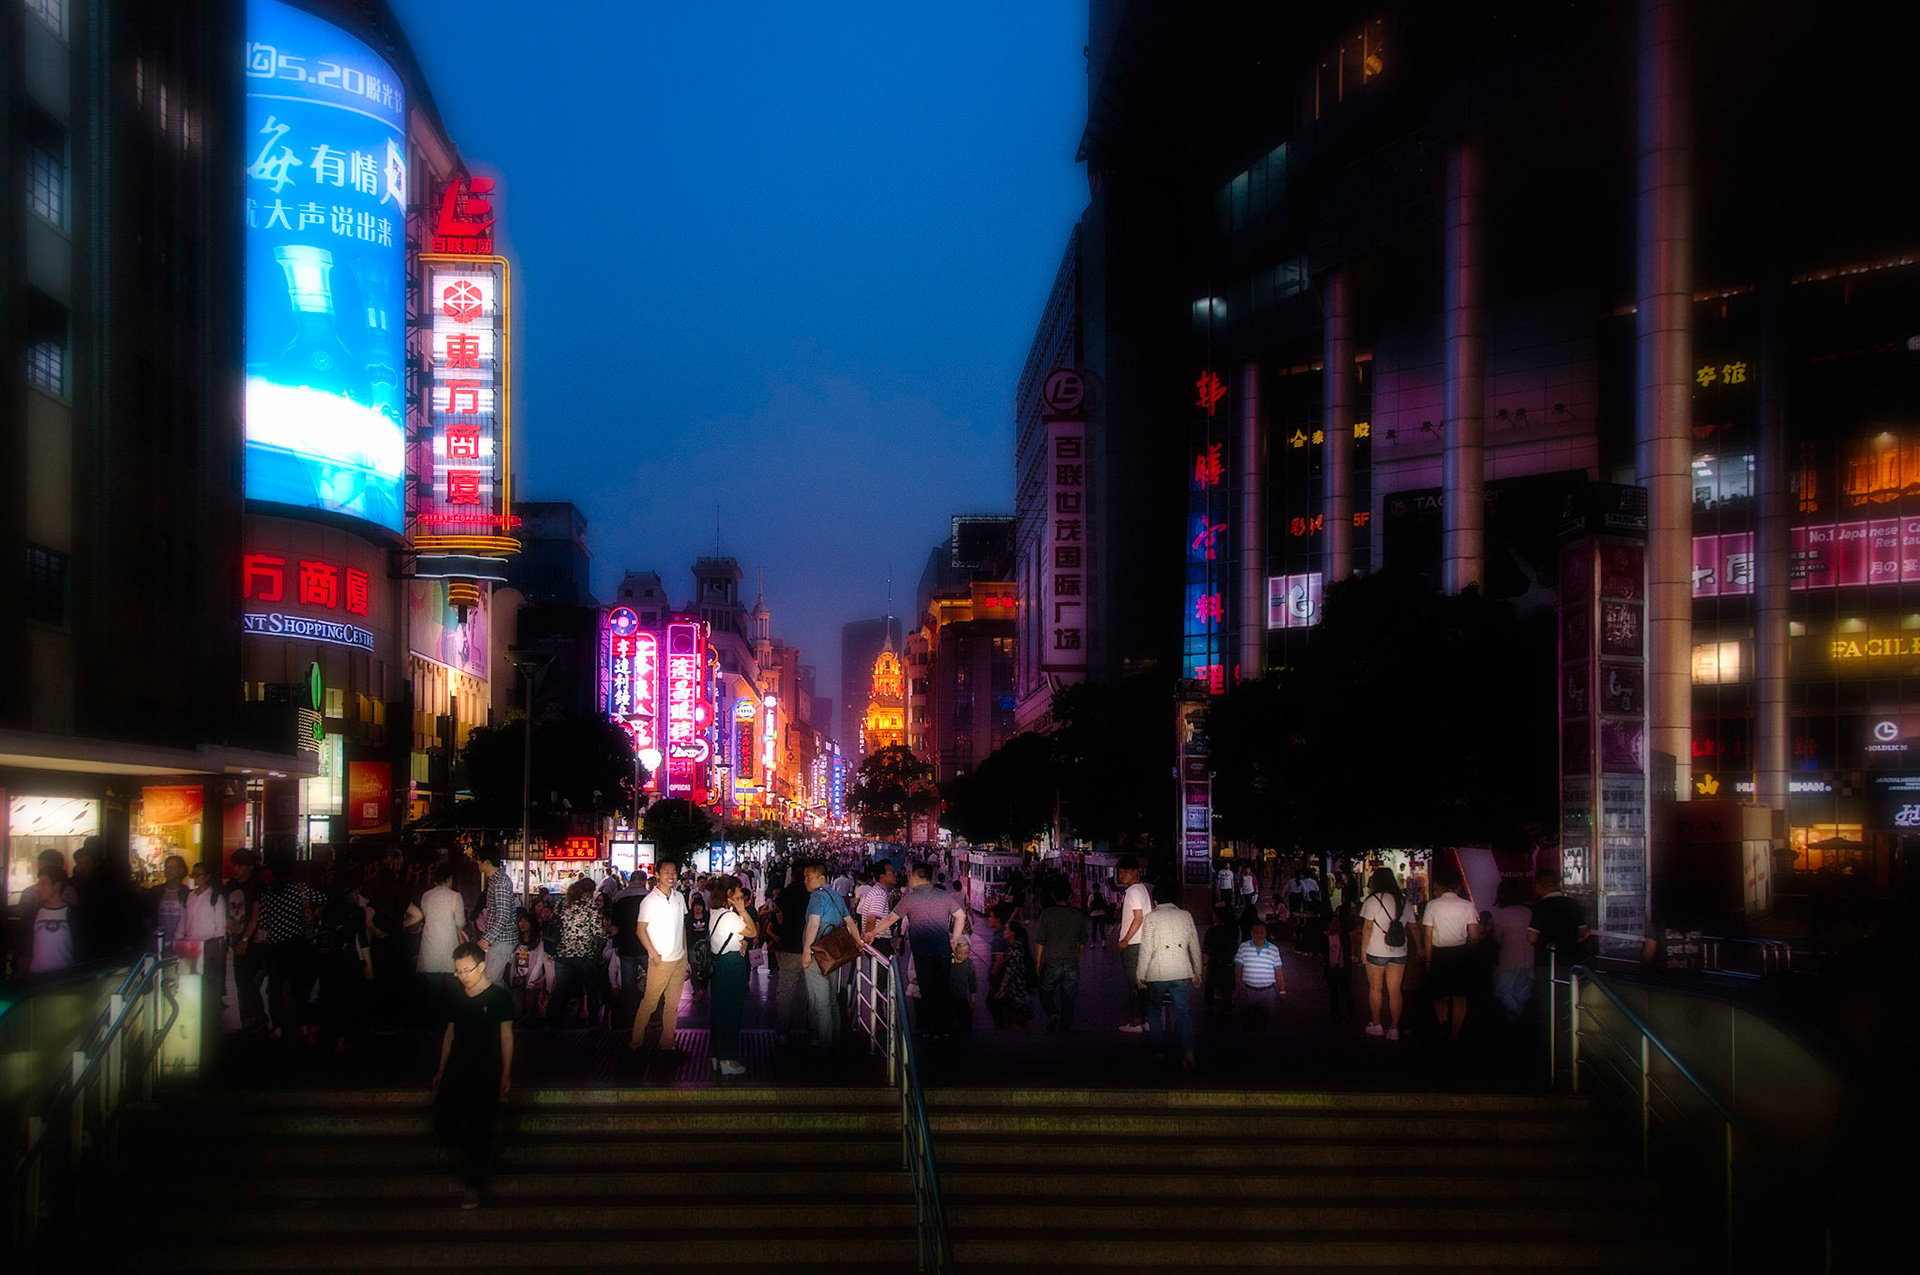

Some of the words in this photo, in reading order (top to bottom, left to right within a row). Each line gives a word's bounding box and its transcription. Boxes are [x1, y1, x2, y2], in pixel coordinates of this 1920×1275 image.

[432, 237, 492, 253] 百联集团
[1054, 436, 1082, 650] 百联世茂国际广场
[1809, 529, 1835, 543] No.1
[1838, 527, 1898, 540] Japanese
[243, 553, 369, 617] 方商厦
[268, 613, 343, 640] SHOPPING
[343, 624, 375, 648] CENTRE
